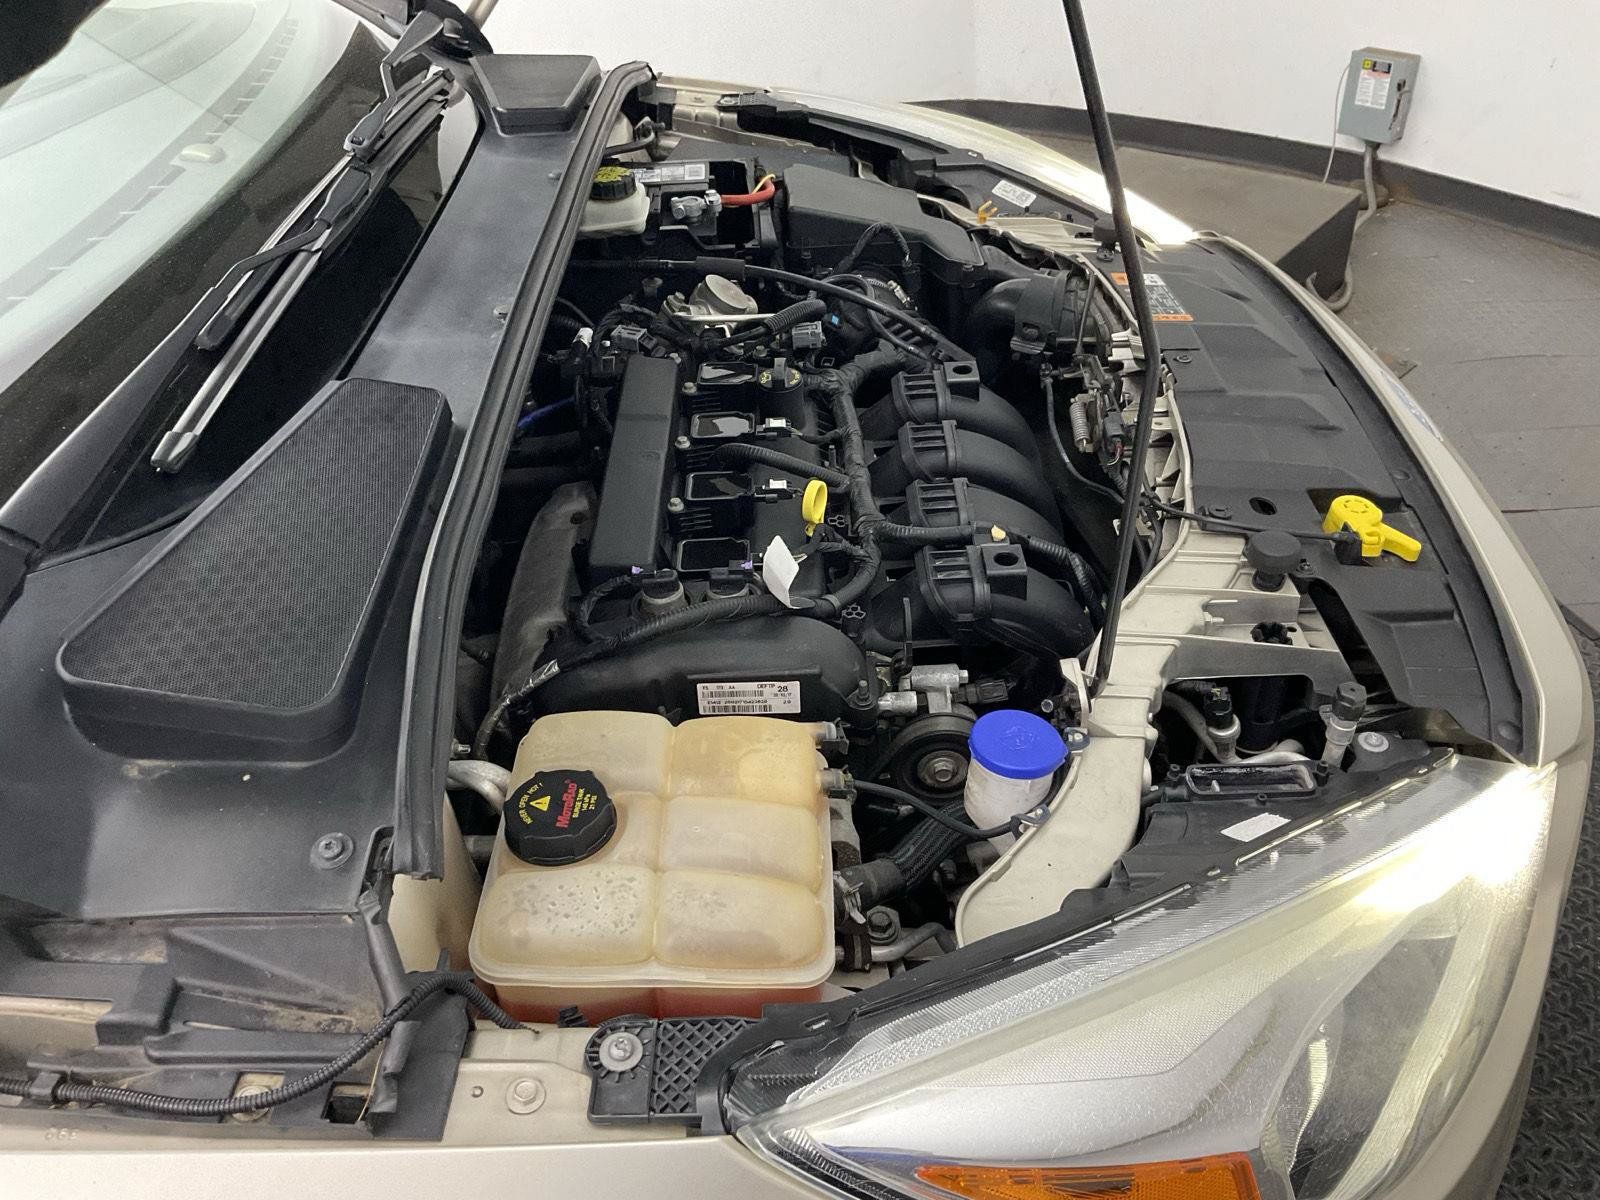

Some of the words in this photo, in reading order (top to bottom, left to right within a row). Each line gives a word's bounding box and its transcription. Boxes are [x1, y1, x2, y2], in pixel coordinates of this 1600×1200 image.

[777, 685, 789, 693] 28
[519, 794, 531, 809] OPEN
[527, 784, 540, 795] HOT
